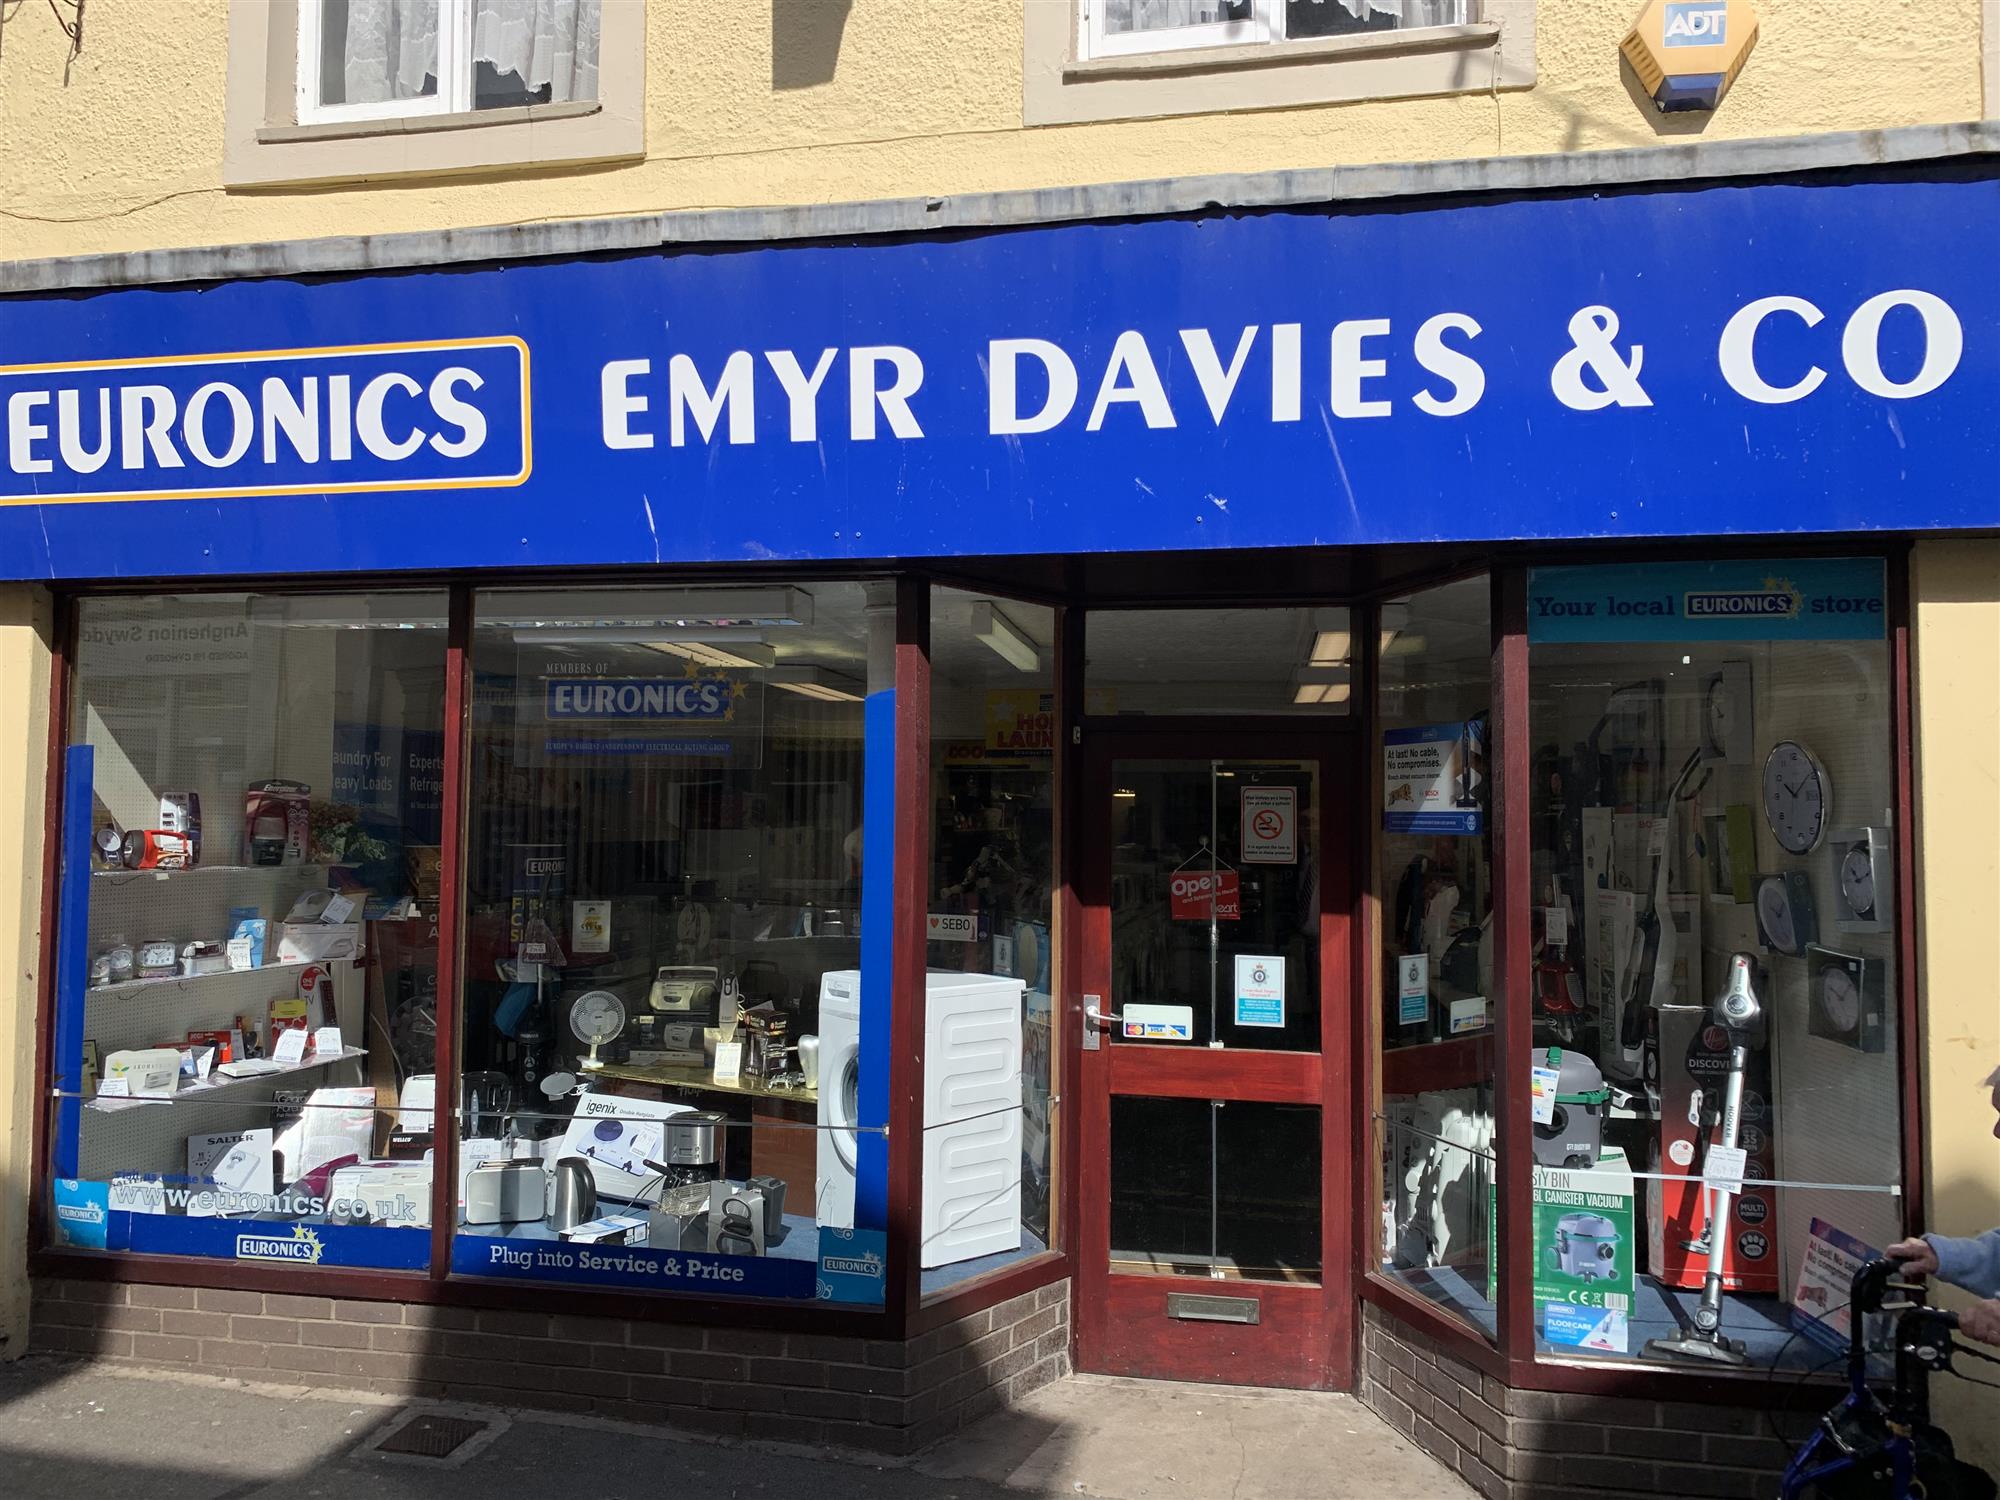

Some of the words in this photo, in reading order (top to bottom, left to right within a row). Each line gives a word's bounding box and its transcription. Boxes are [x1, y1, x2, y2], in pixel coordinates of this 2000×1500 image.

[1664, 9, 1727, 38] ADT
[601, 344, 926, 450] EMYR
[988, 311, 1486, 436] DAVIES
[1550, 304, 1655, 411] &
[1717, 288, 1964, 405] CO
[7, 366, 488, 475] EURONICS
[1534, 596, 1597, 618] Your
[1607, 593, 1676, 618] local
[1691, 594, 1790, 613] EURONICS
[1810, 595, 1884, 615] store
[545, 662, 592, 675] MEMBERS
[595, 662, 610, 675] OF
[554, 684, 721, 714] EURONICS
[1017, 713, 1054, 731] HO
[996, 730, 1054, 748] LAUN
[333, 750, 372, 770] aundry
[373, 751, 392, 768] For
[333, 776, 361, 794] eavy
[362, 775, 393, 792] Loads
[409, 776, 444, 796] Refrige
[529, 859, 566, 873] EURON
[1171, 873, 1223, 898] Open
[942, 917, 971, 931] SEBO
[586, 1099, 618, 1115] igenix
[207, 1134, 254, 1146] SALTER
[1742, 1134, 1757, 1145] 35
[1551, 1172, 1570, 1189] BIN
[114, 1184, 417, 1222] www.euronics.co.uk
[1545, 1190, 1585, 1206] CANISTER
[1585, 1193, 1624, 1209] VACUUM
[1739, 1203, 1765, 1212] MULTI
[60, 1206, 99, 1221] EURONICS
[241, 1239, 311, 1258] EURONICS
[490, 1244, 533, 1270] Plug
[537, 1247, 574, 1269] into
[578, 1250, 660, 1275] Service
[663, 1257, 682, 1277] &
[686, 1258, 746, 1283] Price
[825, 1259, 877, 1275] EURONICS
